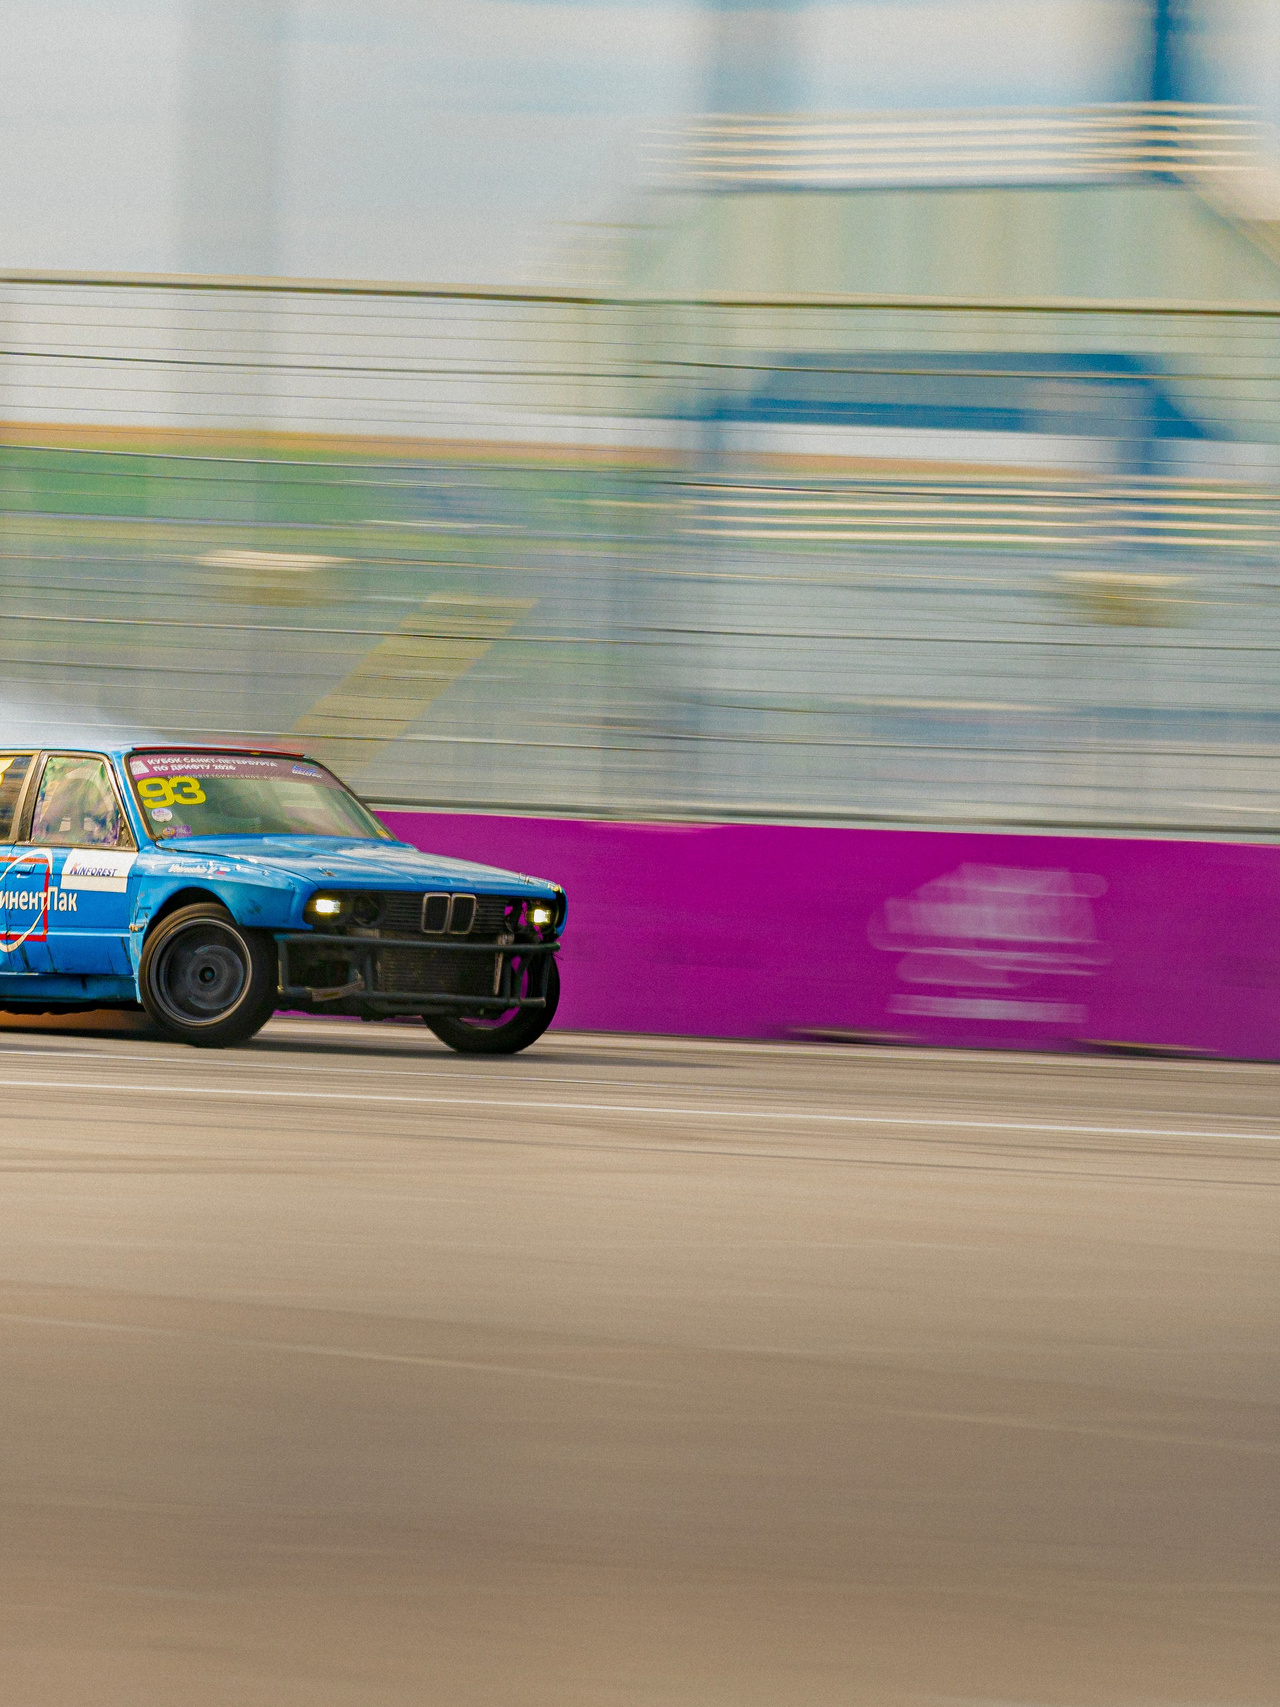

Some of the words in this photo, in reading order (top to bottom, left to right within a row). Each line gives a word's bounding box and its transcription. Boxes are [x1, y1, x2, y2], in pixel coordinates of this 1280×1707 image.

[147, 757, 181, 765] КУБОК
[170, 764, 211, 772] ДРИФТУ
[137, 777, 207, 809] 93
[69, 862, 118, 877] KINFOREST
